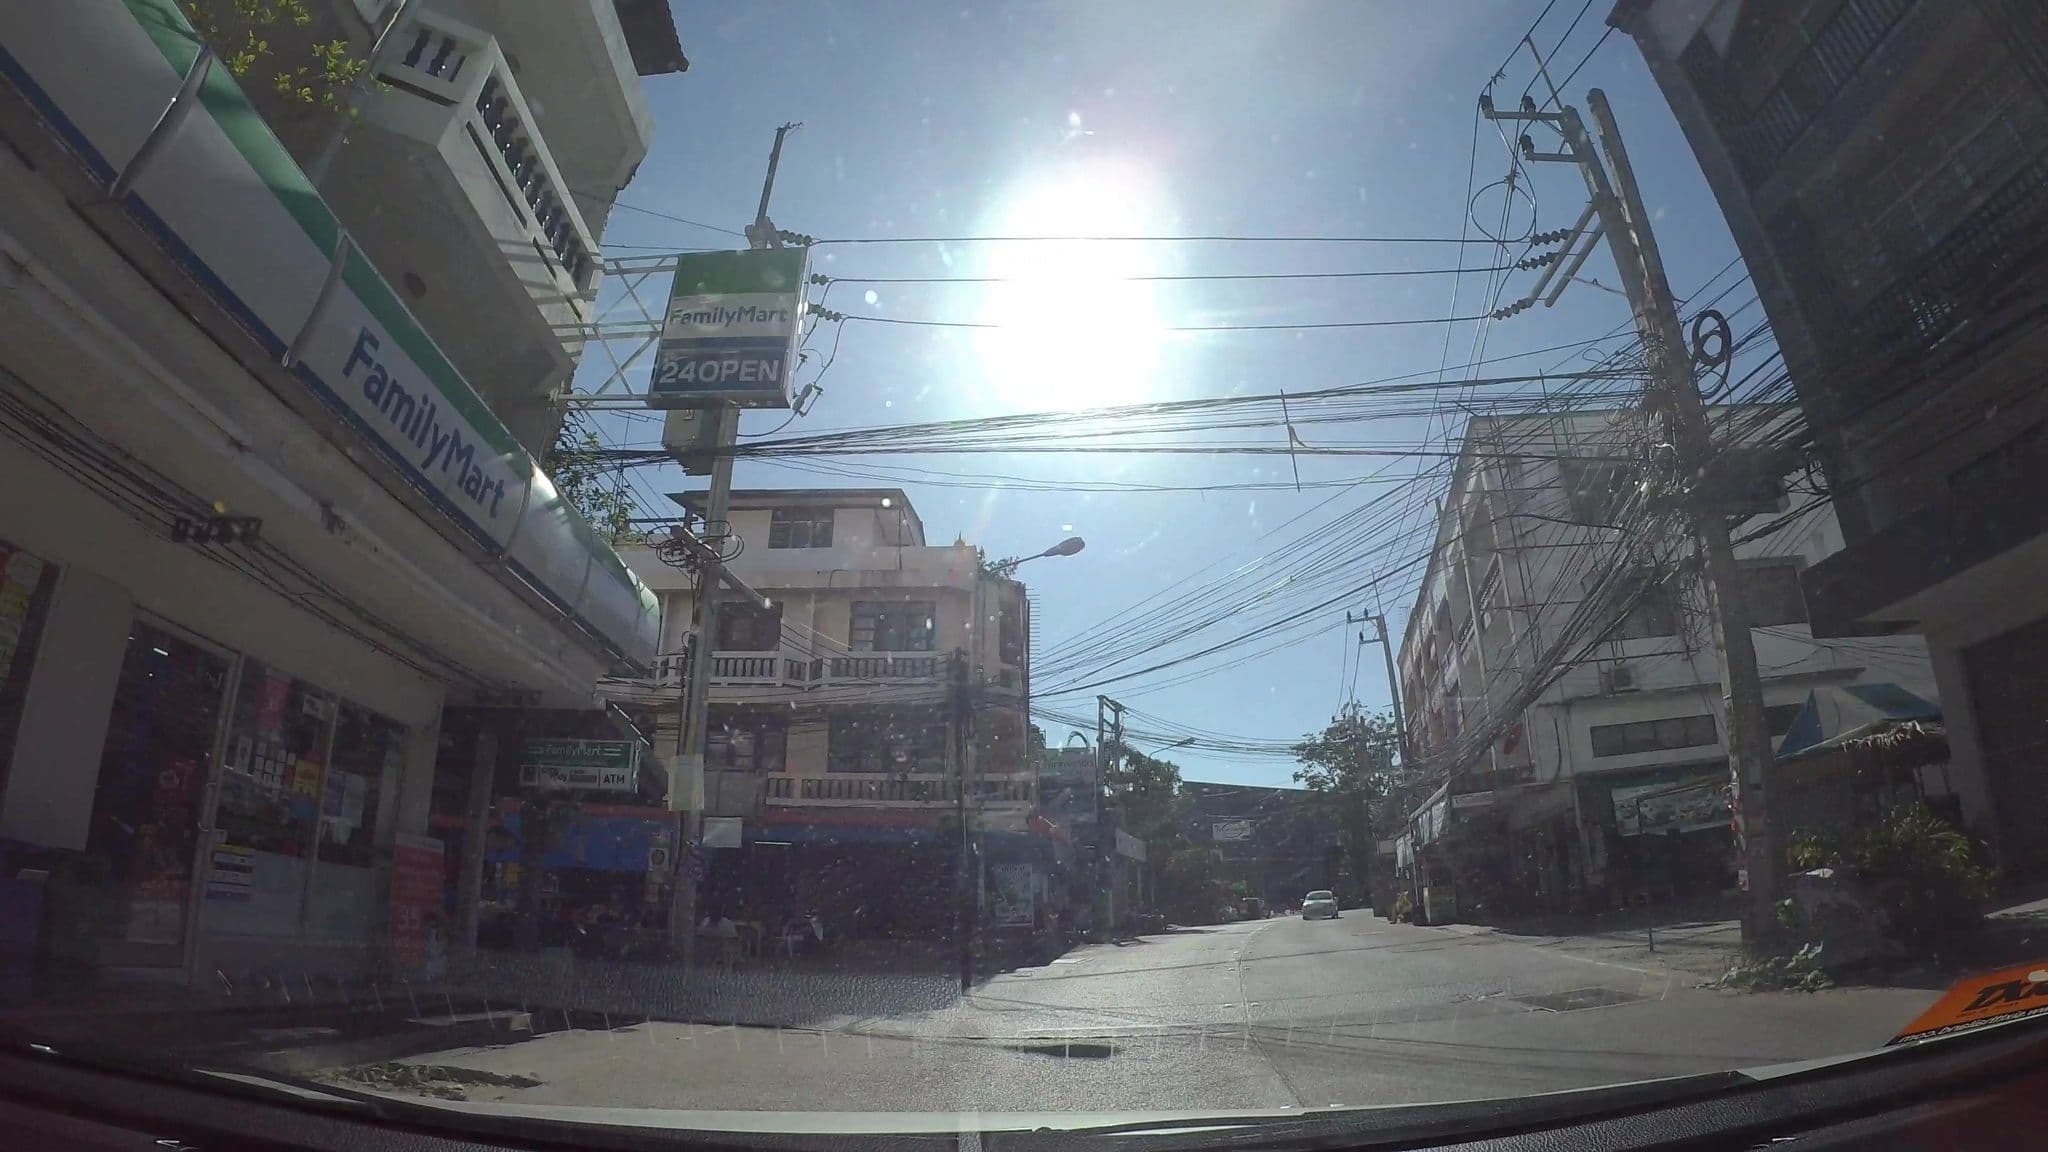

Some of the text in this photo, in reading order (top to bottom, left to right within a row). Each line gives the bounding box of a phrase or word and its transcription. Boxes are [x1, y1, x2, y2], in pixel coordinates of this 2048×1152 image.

[670, 305, 788, 328] FamilyMart
[342, 325, 505, 519] FamilyMart
[546, 744, 601, 757] FamilyMart
[603, 774, 625, 785] ATM
